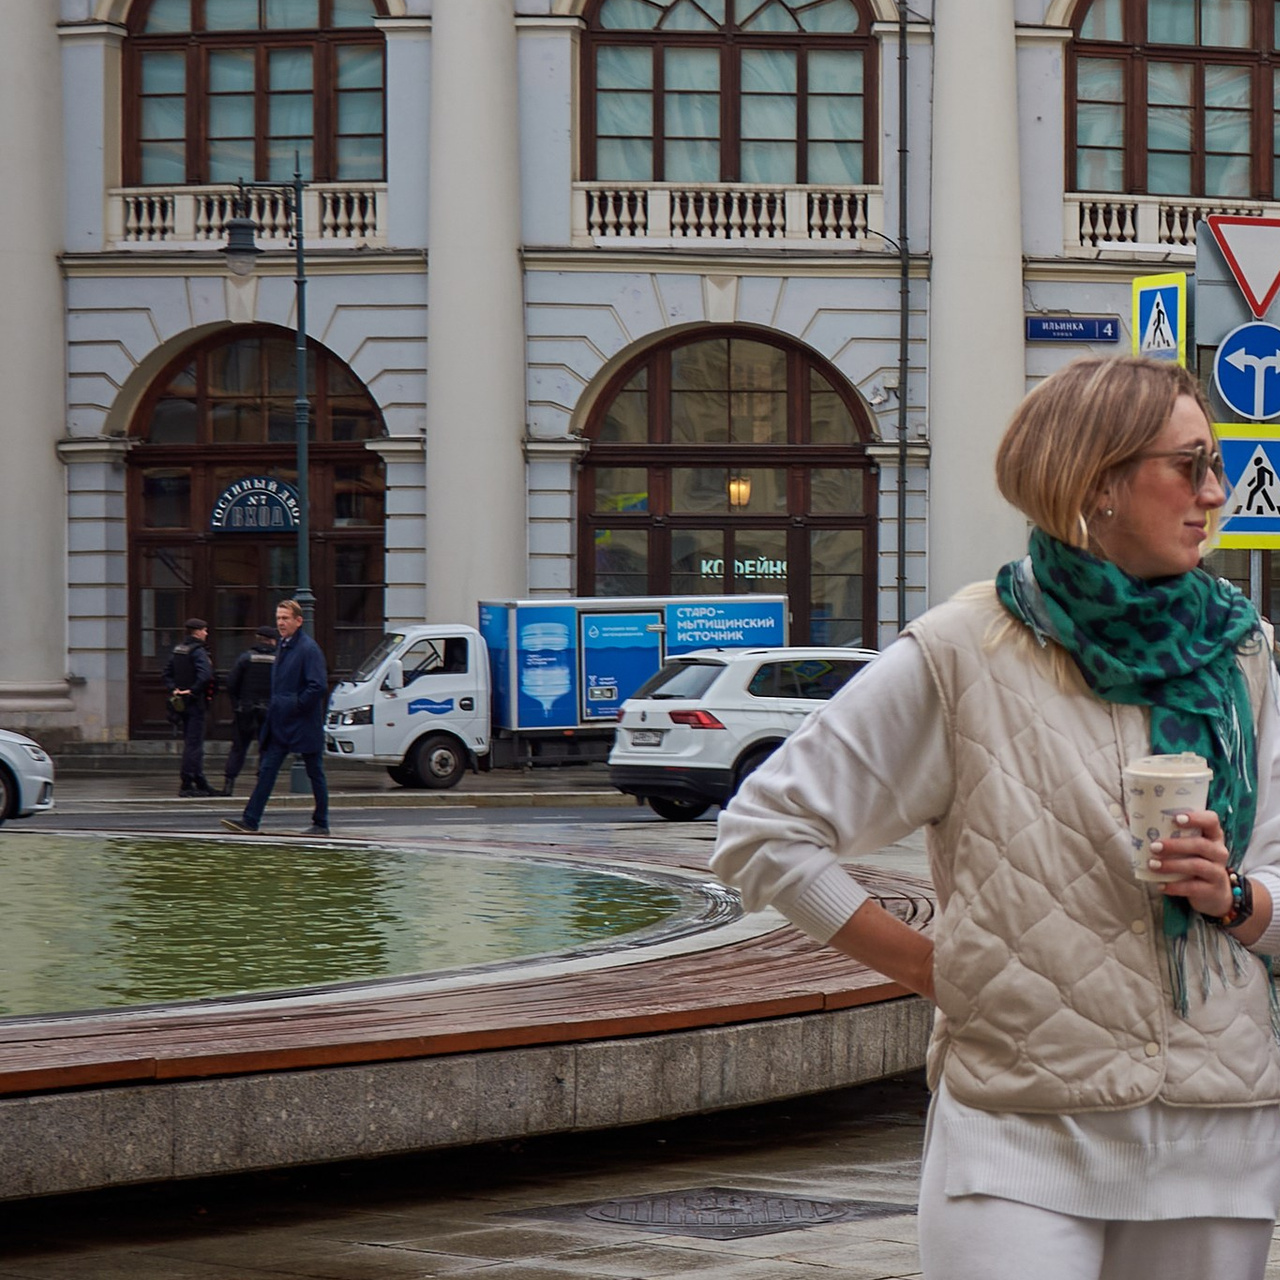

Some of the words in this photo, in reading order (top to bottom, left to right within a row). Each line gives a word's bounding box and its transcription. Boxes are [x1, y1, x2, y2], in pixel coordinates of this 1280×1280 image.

[1042, 322, 1084, 331] ИЛЬИНКА
[1103, 323, 1113, 336] 4
[212, 479, 278, 526] ГОСТИНЫЙ
[231, 506, 284, 527] ВХОД
[677, 617, 775, 630] МЫТИЩИНСКИЙ
[677, 631, 744, 641] ИСТОЧНИК
